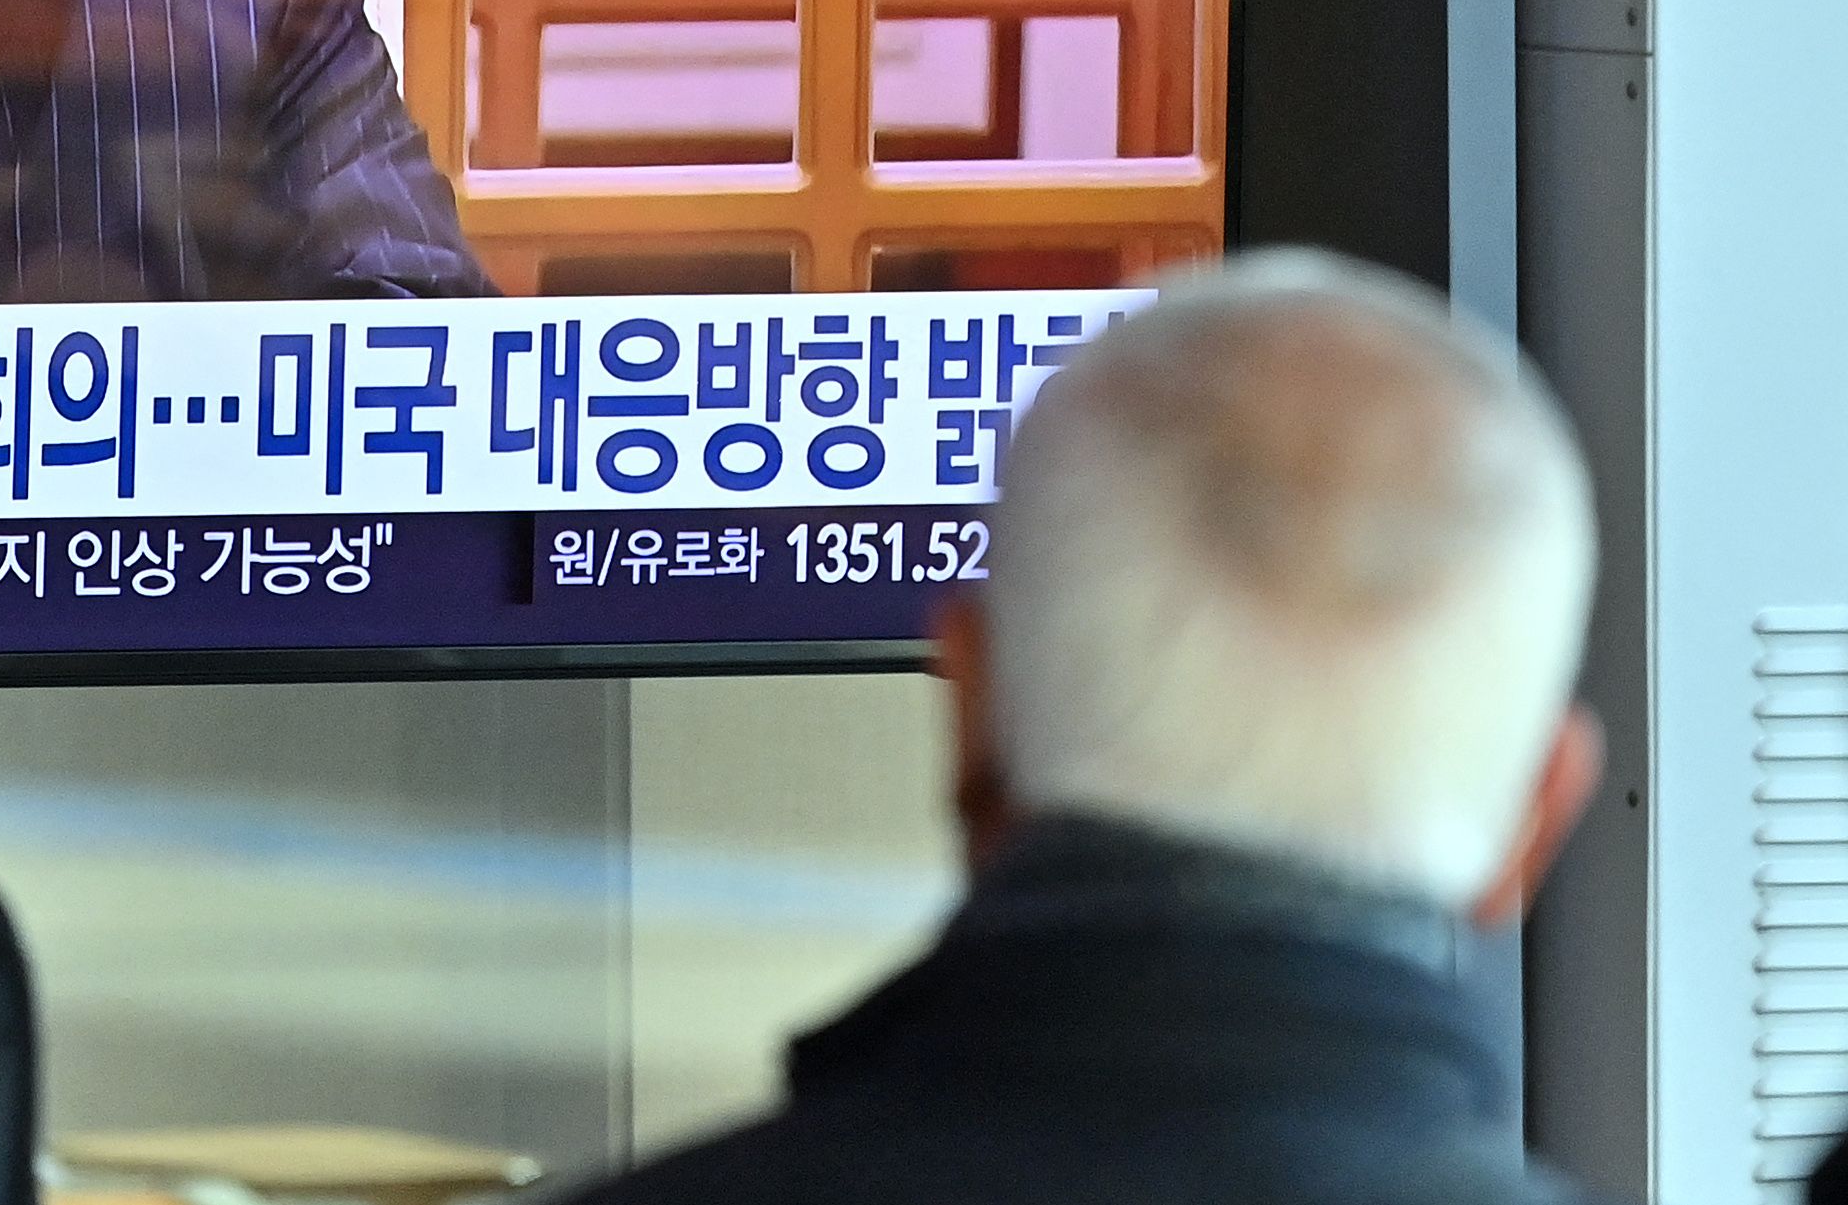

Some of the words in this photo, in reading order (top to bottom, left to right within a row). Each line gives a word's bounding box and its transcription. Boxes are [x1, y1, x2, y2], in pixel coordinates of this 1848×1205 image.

[489, 315, 899, 494] 대응방향
[67, 528, 185, 597] 인상
[549, 527, 765, 586] 원/유로화
[786, 521, 990, 584] 1351.52
